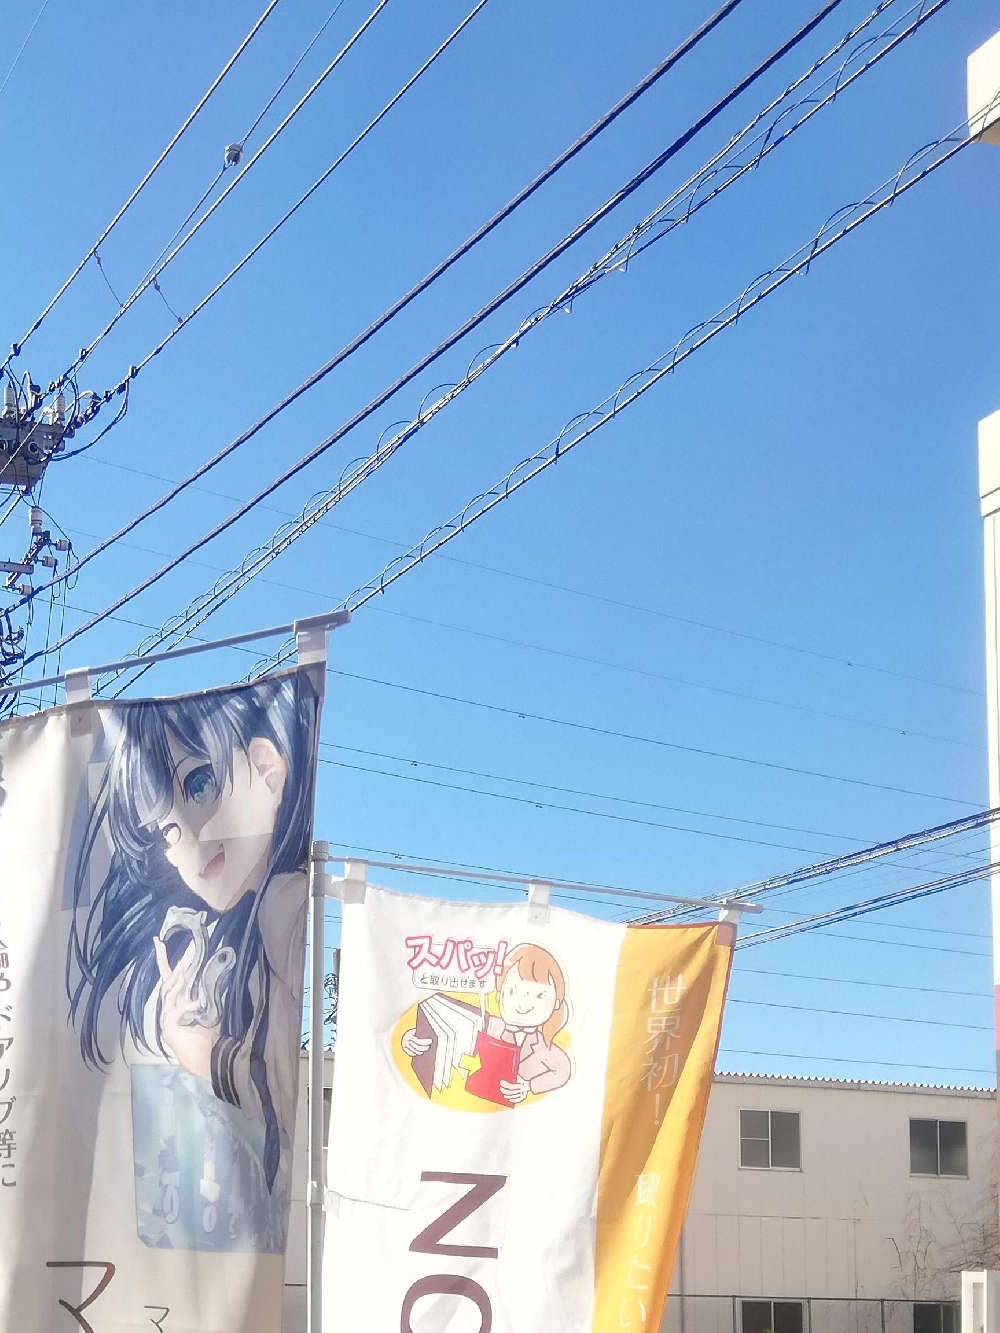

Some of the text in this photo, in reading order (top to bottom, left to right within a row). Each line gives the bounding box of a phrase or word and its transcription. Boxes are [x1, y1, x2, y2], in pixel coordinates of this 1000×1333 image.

[420, 973, 487, 988] と取り出せます
